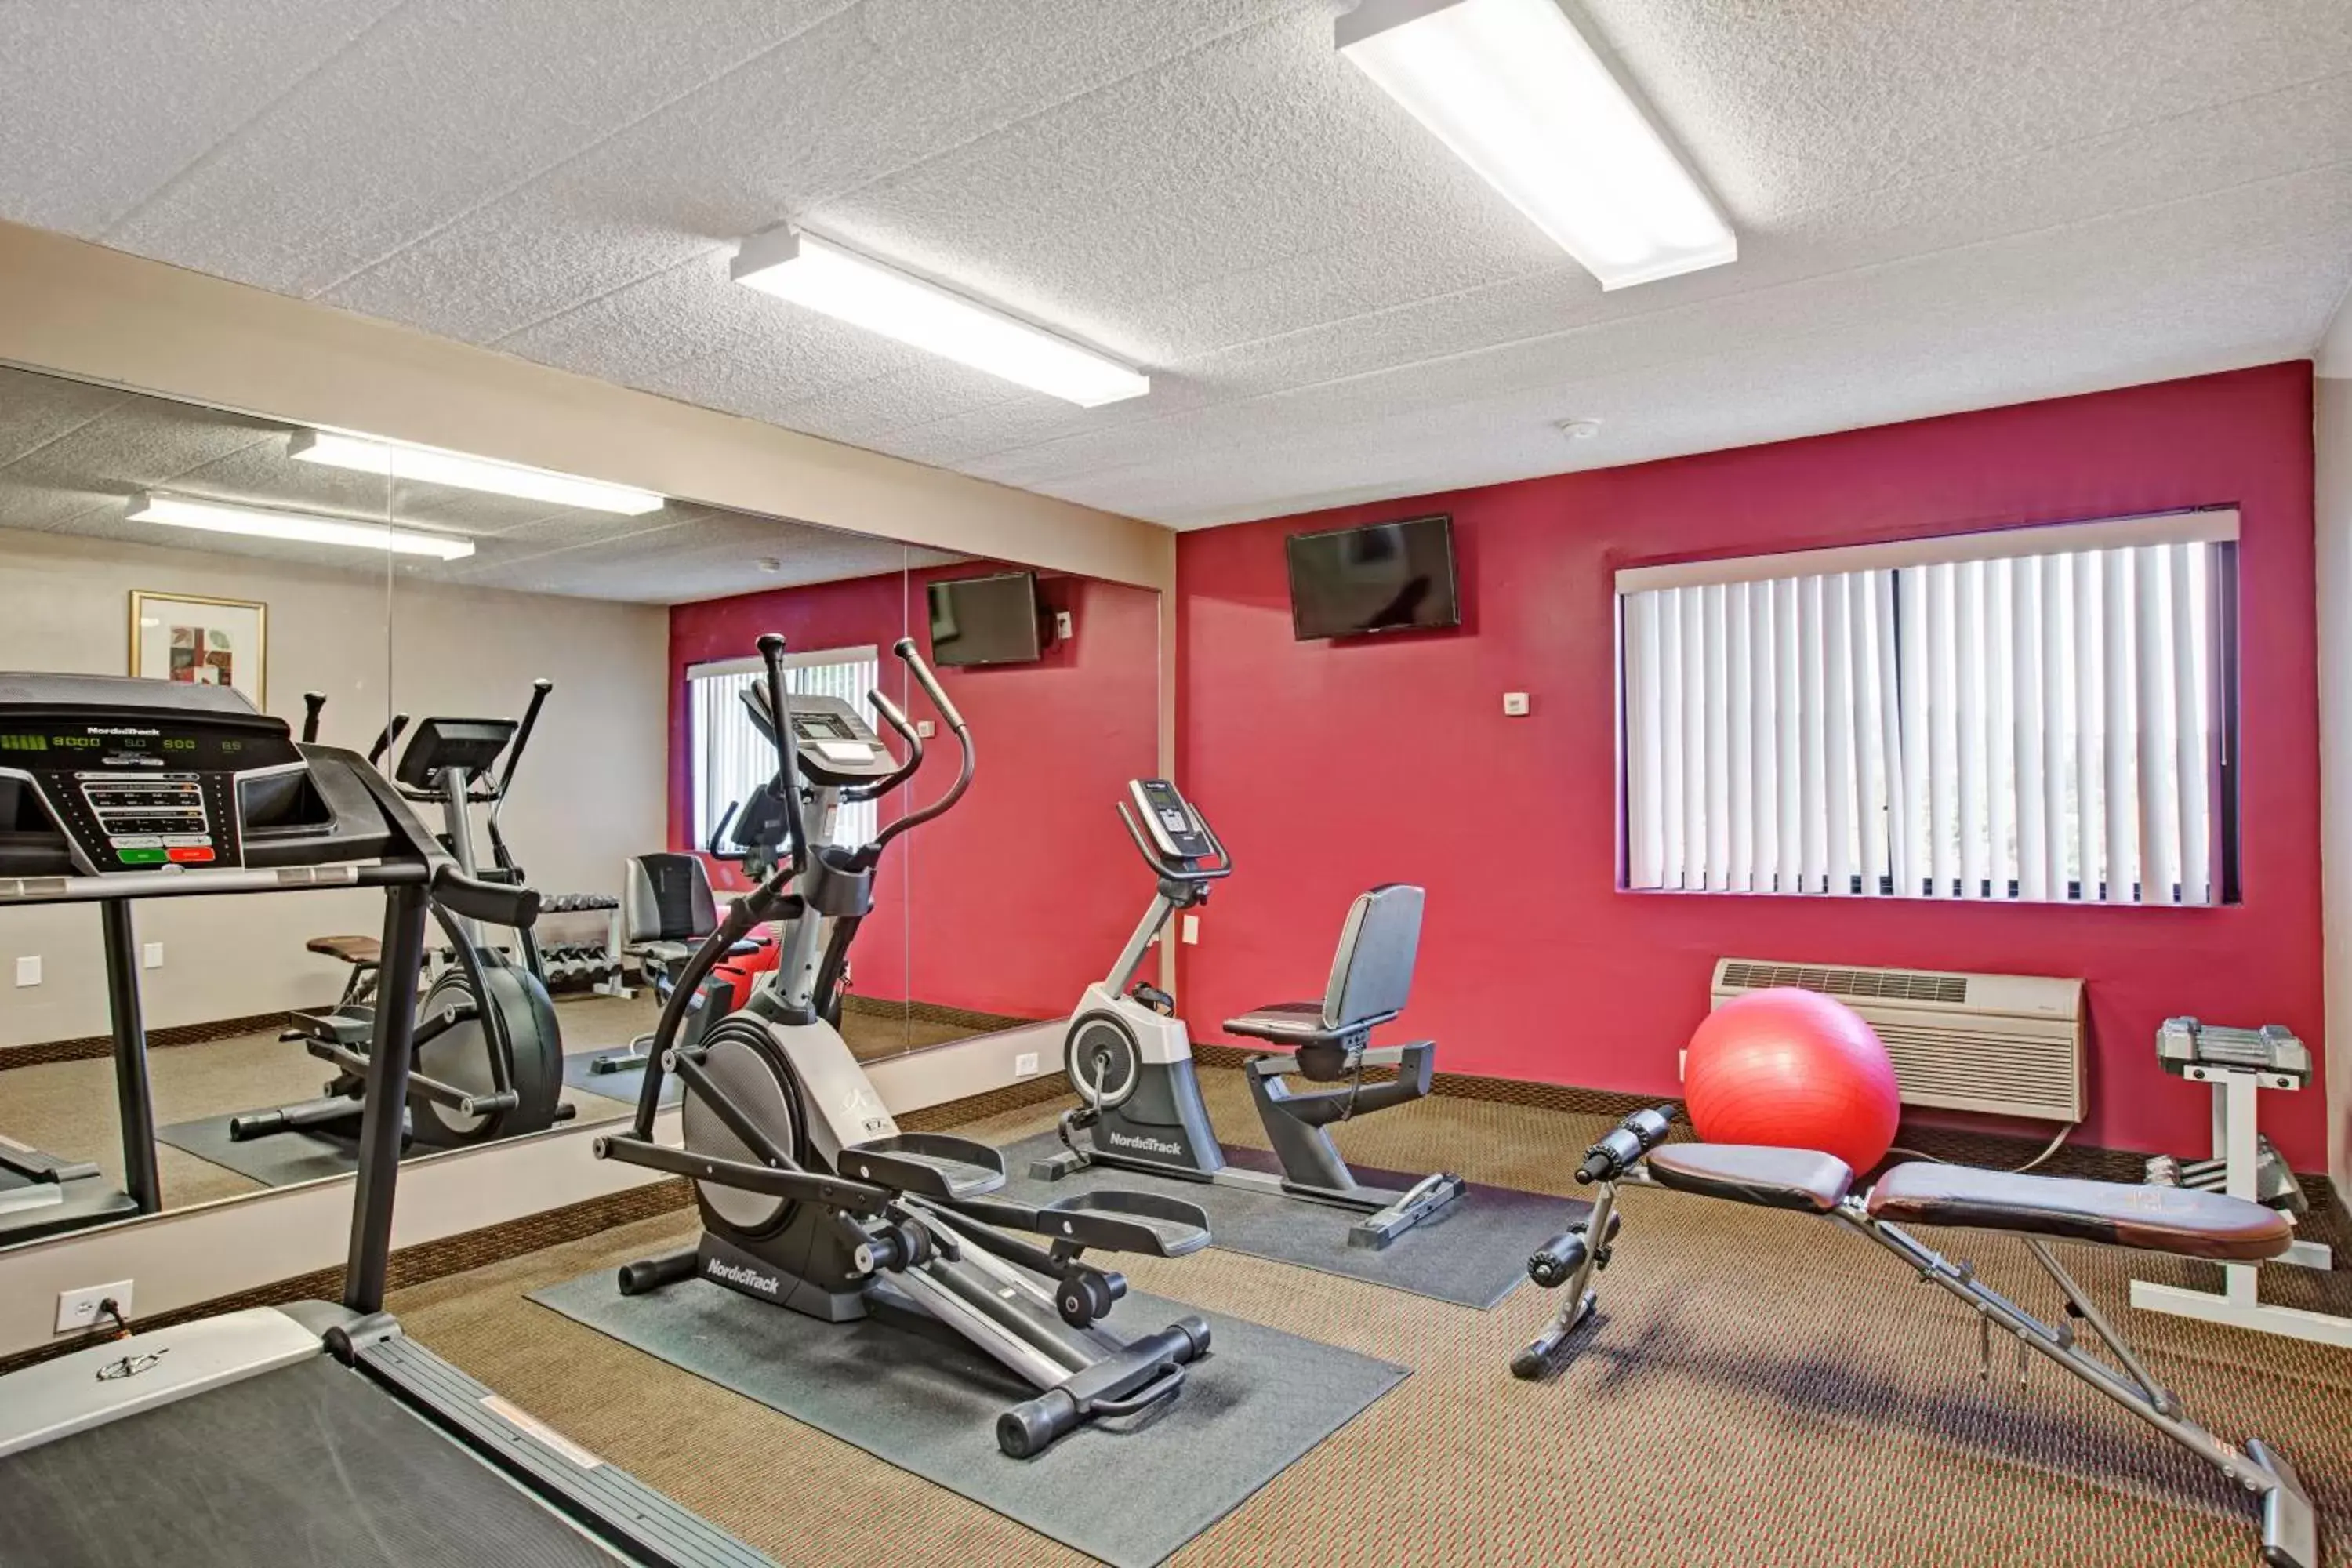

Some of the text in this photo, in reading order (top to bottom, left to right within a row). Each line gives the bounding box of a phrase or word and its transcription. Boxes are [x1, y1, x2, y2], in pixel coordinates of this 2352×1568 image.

[87, 727, 160, 736] NordicTrack
[1109, 1131, 1181, 1155] NordicTrack
[707, 1257, 779, 1294] NordicTrack
